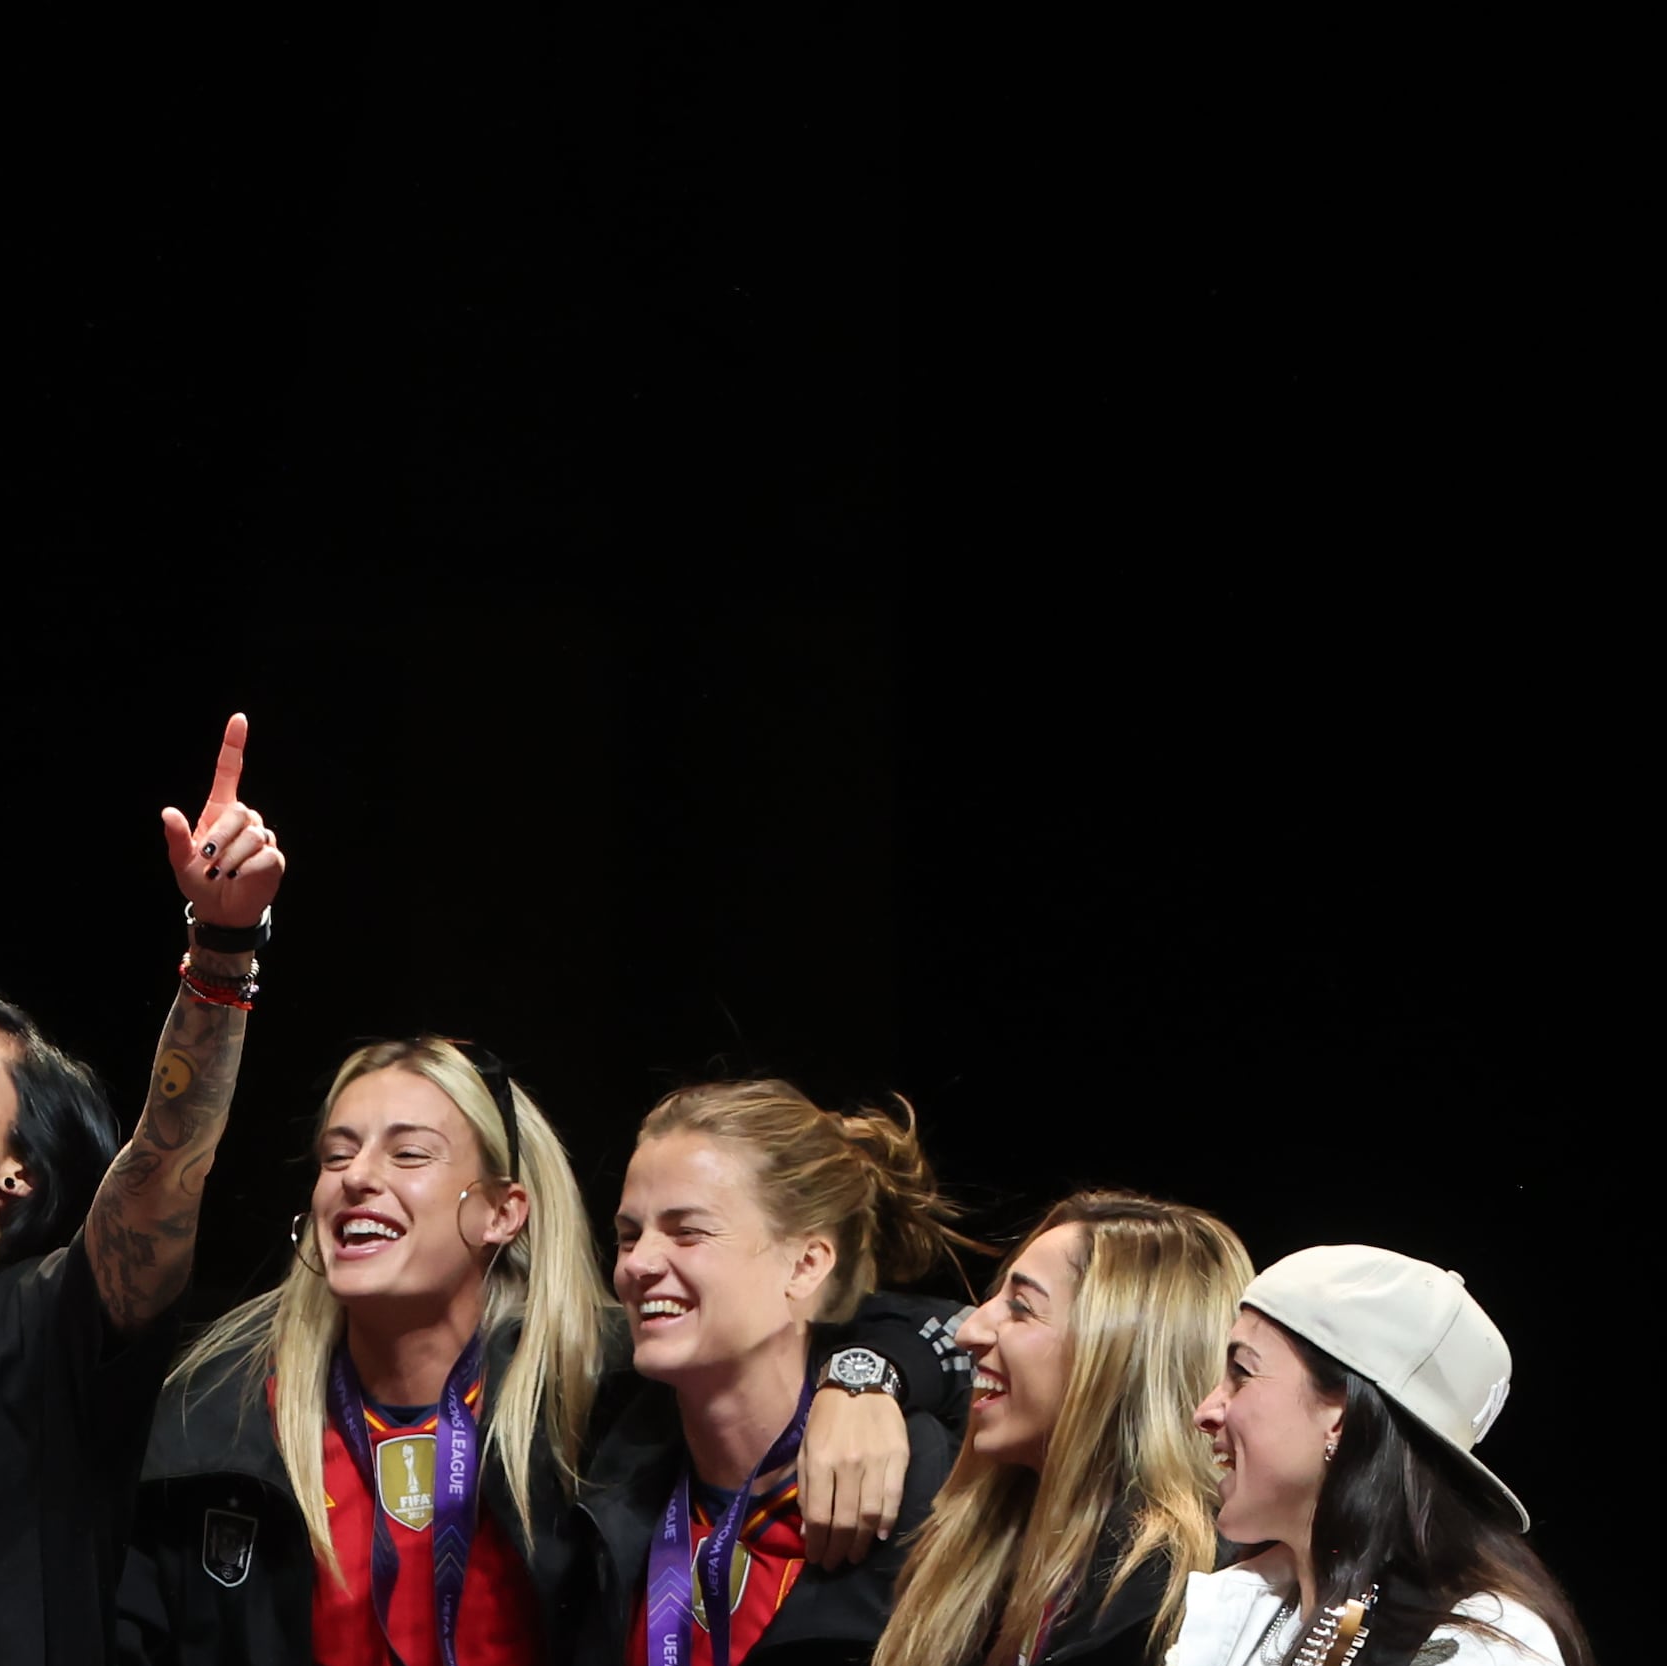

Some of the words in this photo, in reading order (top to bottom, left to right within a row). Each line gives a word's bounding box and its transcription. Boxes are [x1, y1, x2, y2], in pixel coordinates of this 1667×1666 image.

[449, 1429, 466, 1495] LEAGUE
[399, 1493, 431, 1509] FIFA
[707, 1556, 720, 1597] UEFA
